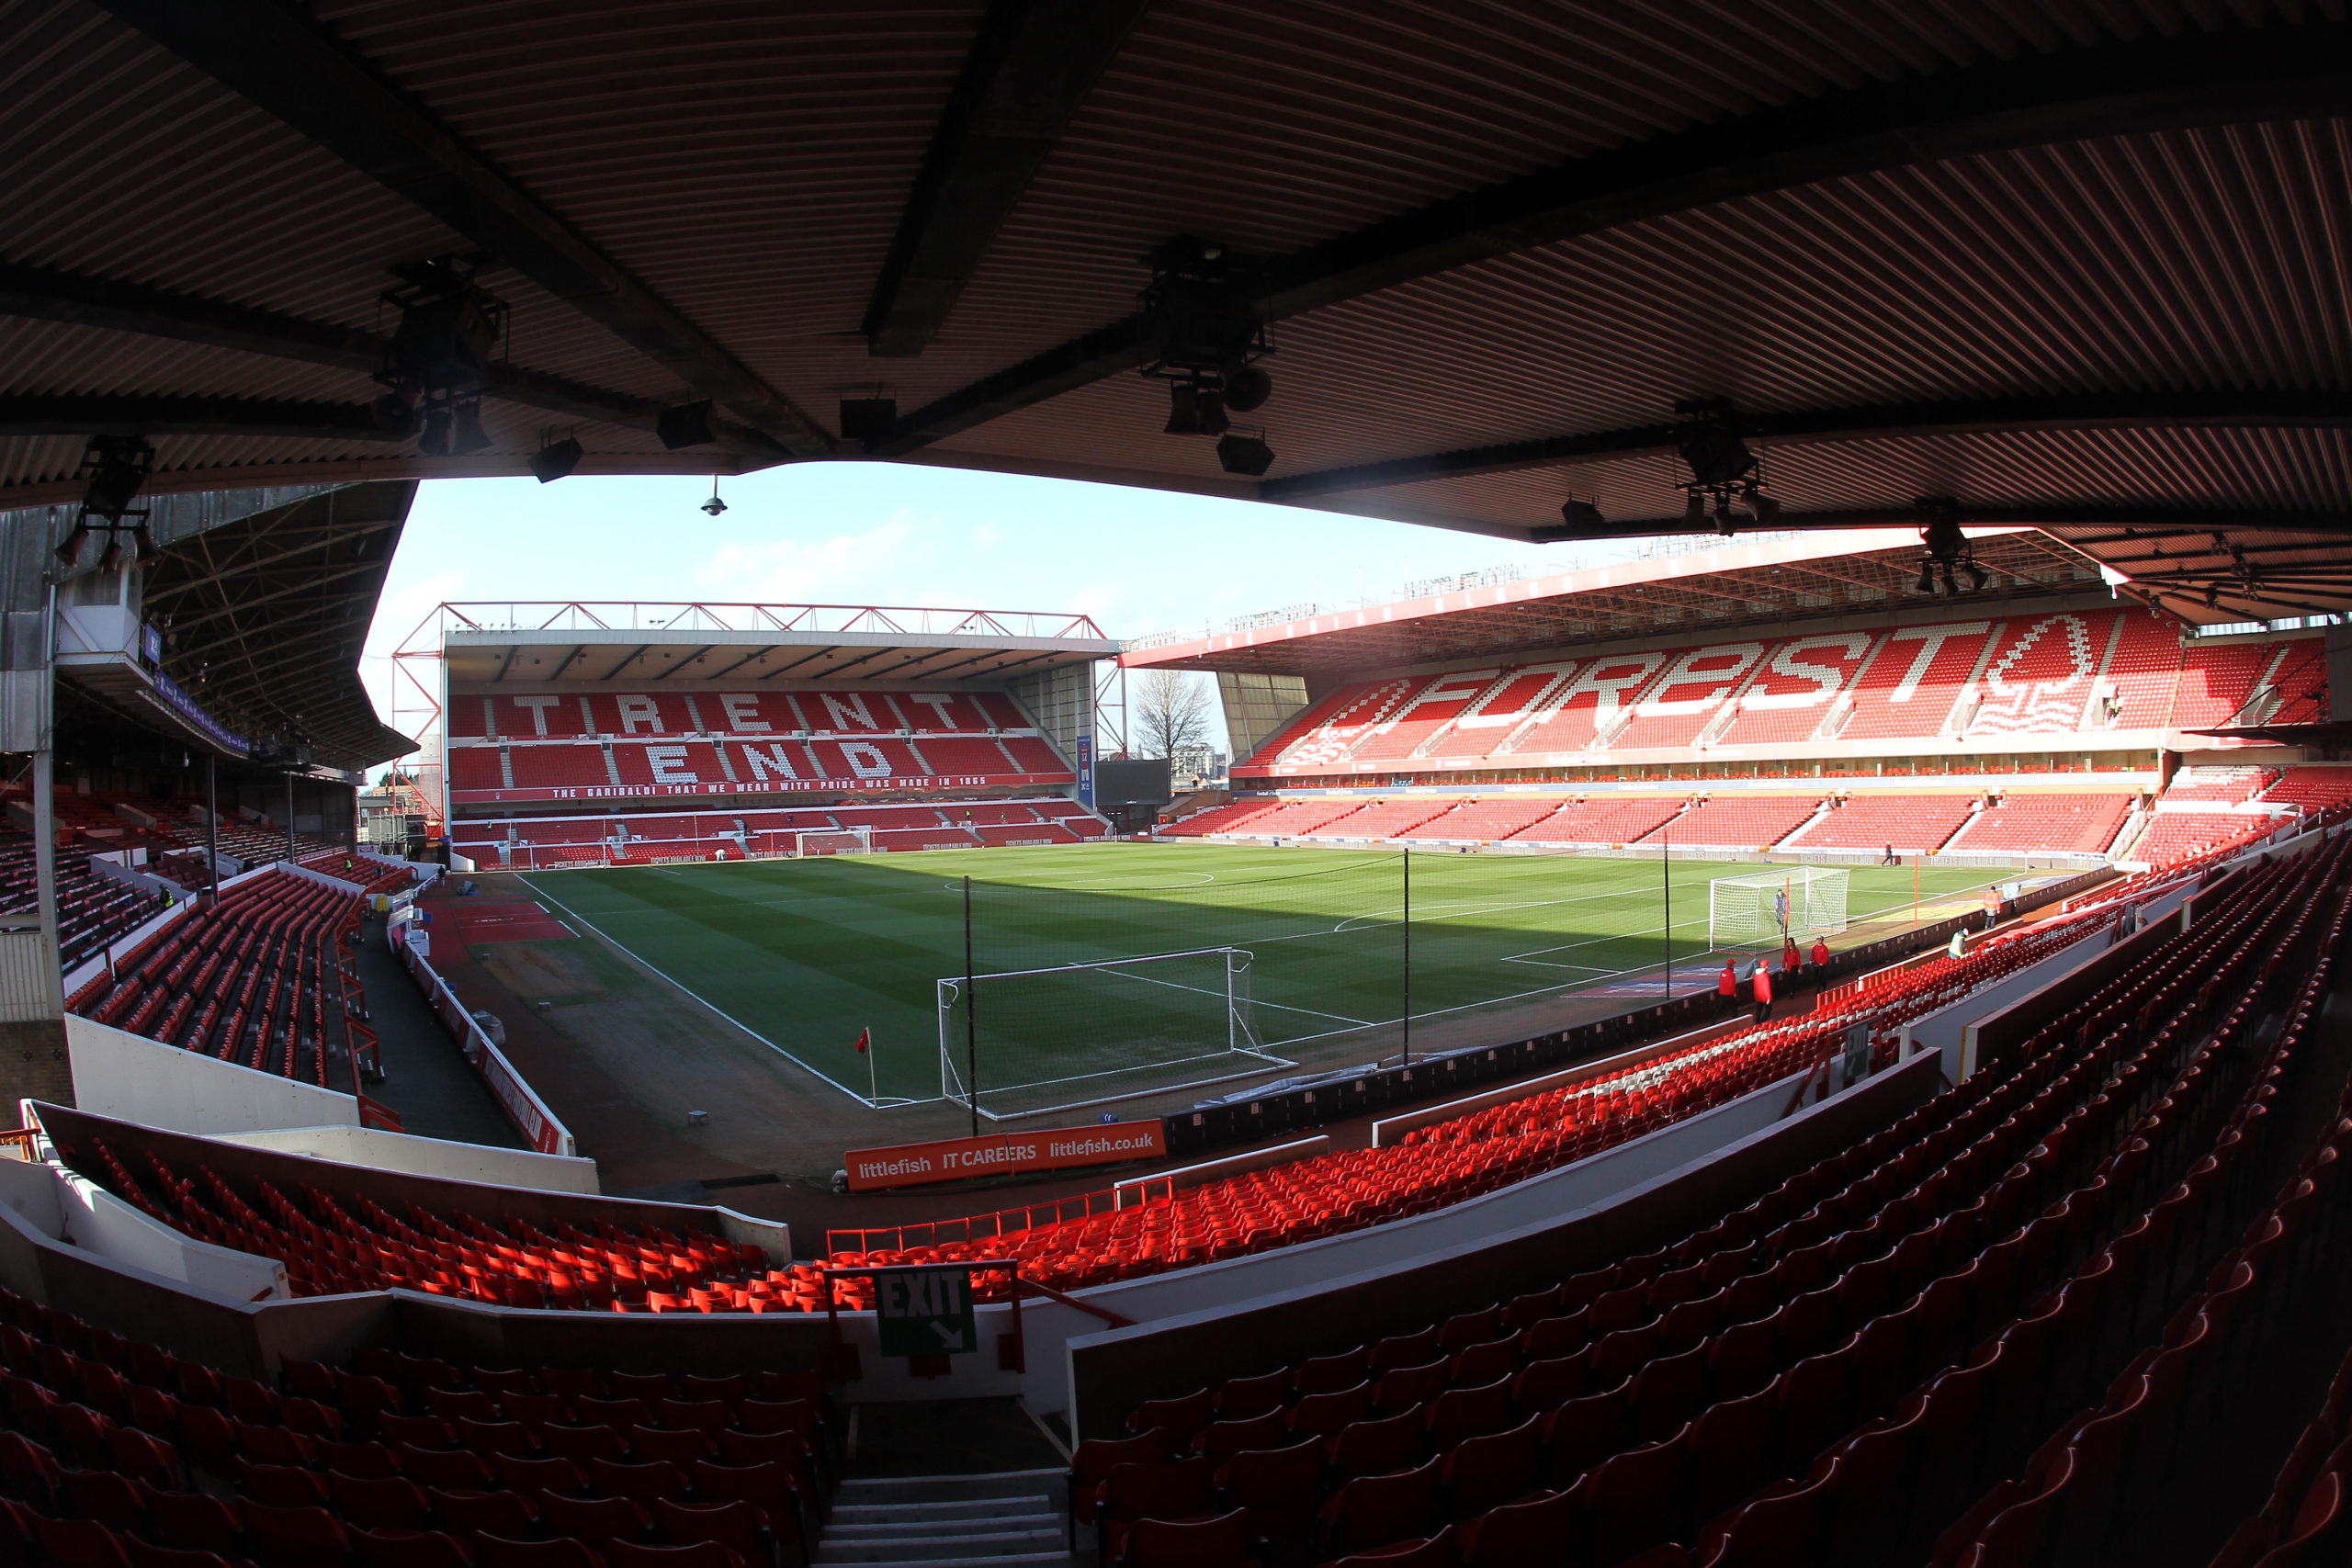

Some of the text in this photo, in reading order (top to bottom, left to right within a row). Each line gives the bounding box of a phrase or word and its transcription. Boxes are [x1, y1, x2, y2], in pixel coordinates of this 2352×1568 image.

[514, 694, 957, 735] TRENT
[645, 742, 893, 784] END
[553, 776, 986, 798] THE GARIBALDI THAT WE WEAR WITH PRIDE WAS MADE IN 1865
[859, 1133, 1153, 1179] littlefish IT CAREERS littlefish.co.uk
[880, 1270, 964, 1318] EXIT
